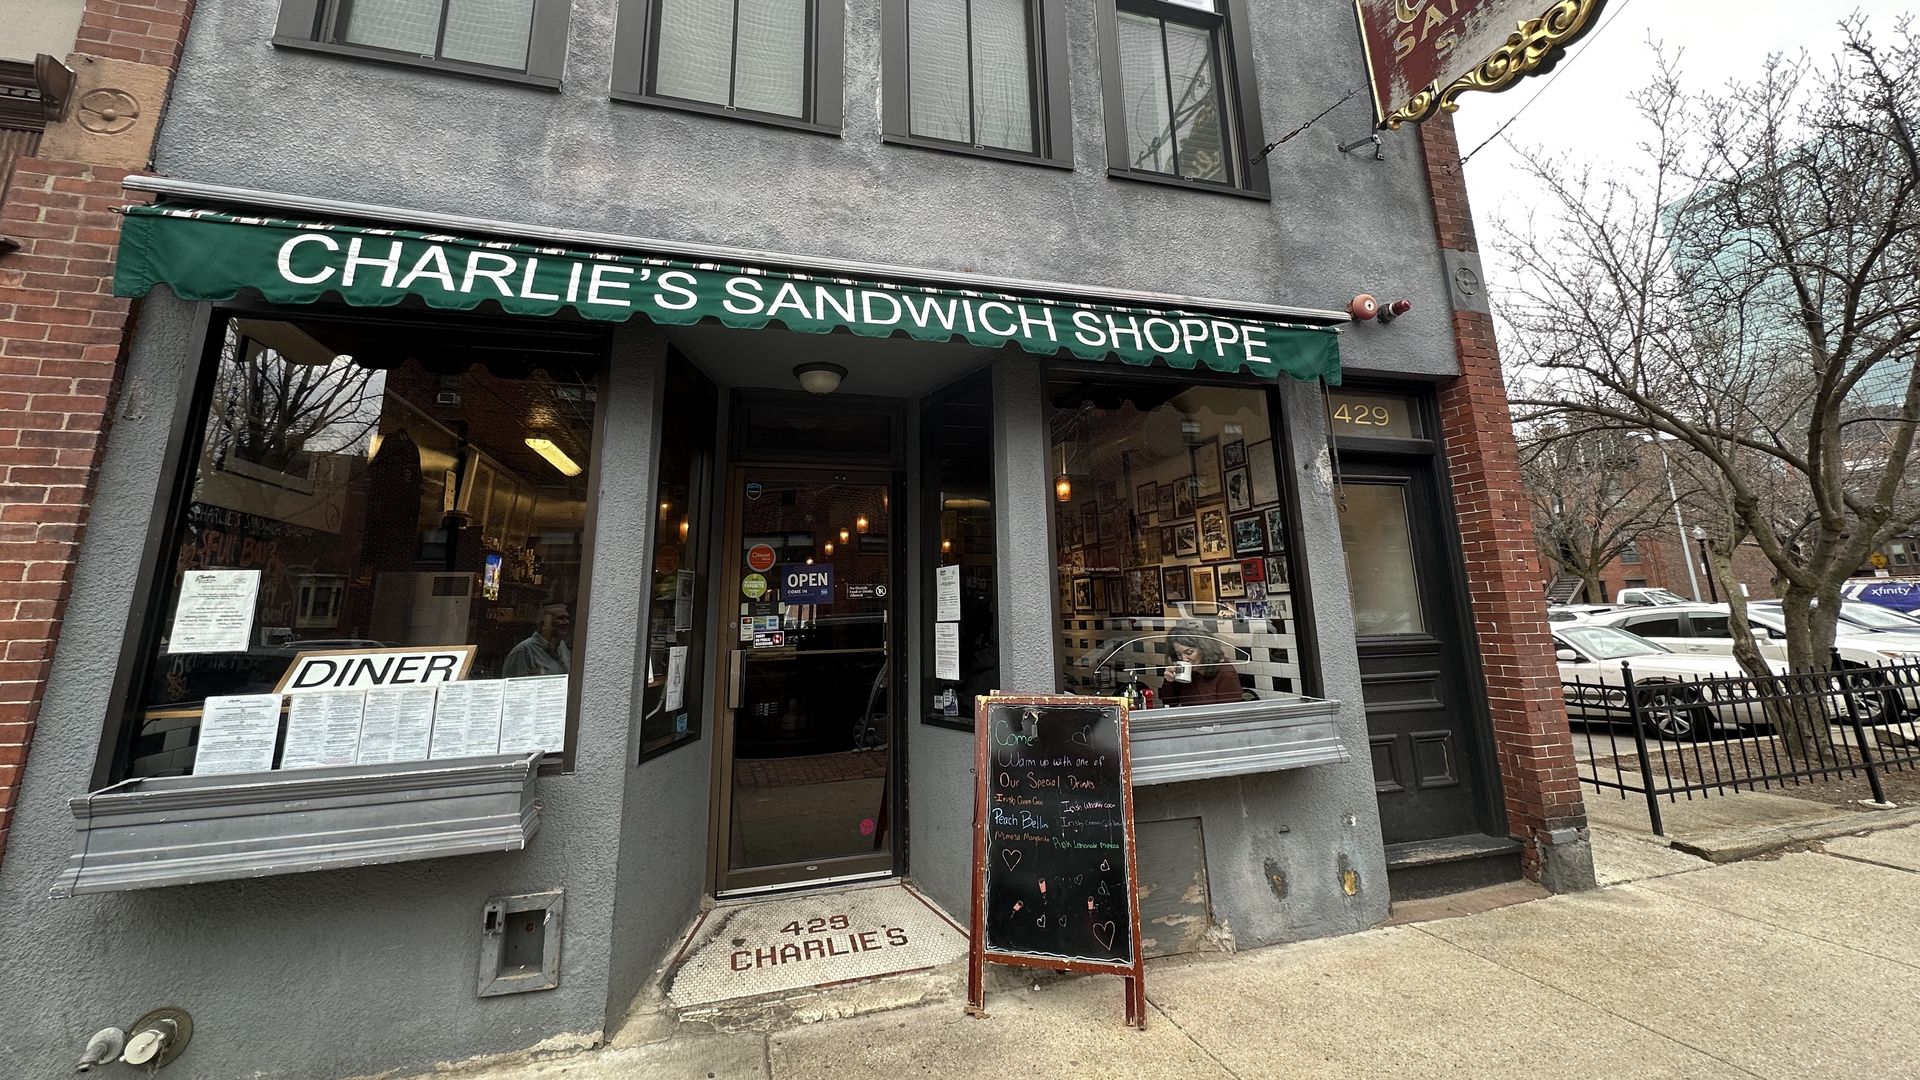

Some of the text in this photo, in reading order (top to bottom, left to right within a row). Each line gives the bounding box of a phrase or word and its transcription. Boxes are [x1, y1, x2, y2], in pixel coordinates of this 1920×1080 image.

[277, 234, 1273, 364] CHARLIE'S SANDWICH SHOPPE
[1333, 403, 1390, 426] 429
[787, 572, 829, 588] OPEN
[1872, 586, 1911, 597] xfinity
[290, 654, 458, 689] DINER
[995, 719, 1034, 747] Come
[997, 749, 1105, 769] Warm up with one of
[999, 771, 1096, 790] Our Special Drinks
[992, 807, 1018, 827] Peach
[1060, 800, 1083, 814] Irish
[780, 914, 850, 936] 429
[730, 924, 909, 972] CHARLIE'S
